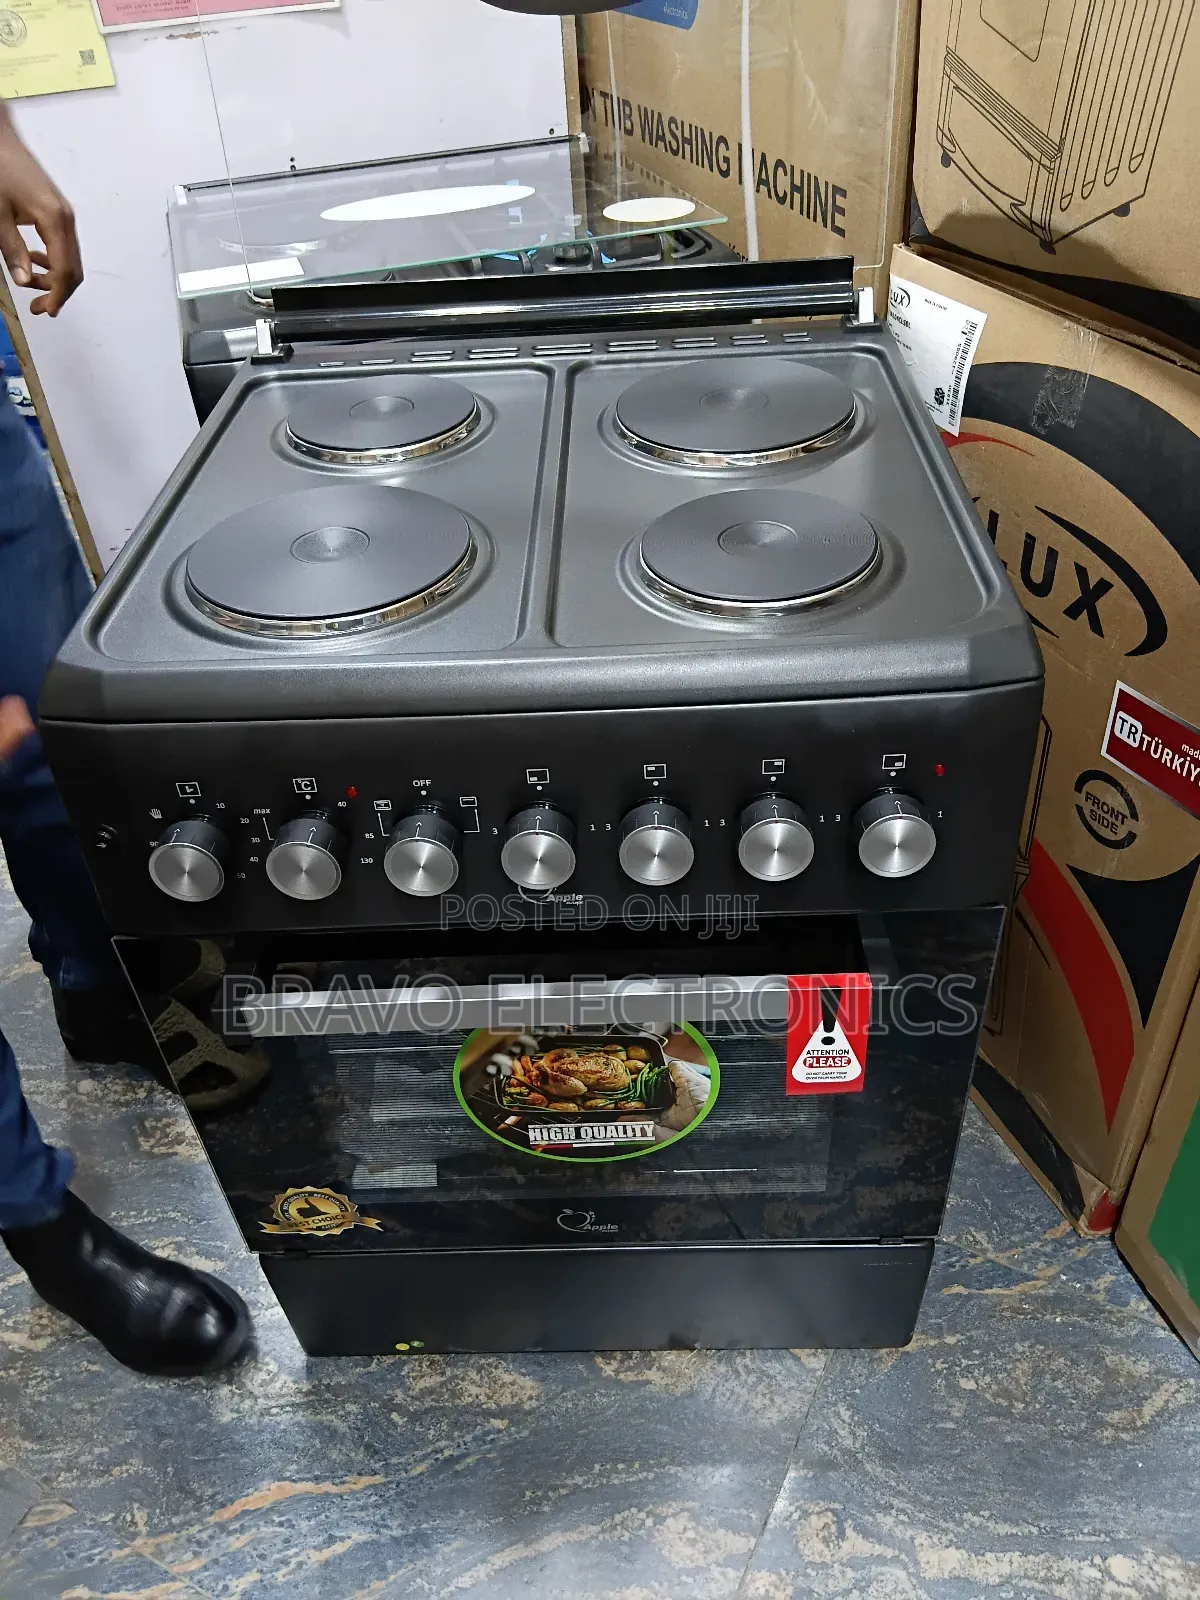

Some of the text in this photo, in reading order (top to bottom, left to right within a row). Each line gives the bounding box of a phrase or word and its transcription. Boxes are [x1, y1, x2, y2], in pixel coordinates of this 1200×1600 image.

[599, 90, 634, 137] TUB
[637, 103, 731, 179] WASHING
[1118, 716, 1200, 787] TR TÜRKİY
[1181, 743, 1200, 761] mad
[413, 779, 432, 788] OFF
[1084, 790, 1129, 825] FRONT
[719, 818, 726, 827] 3
[835, 813, 841, 822] 3
[1089, 808, 1119, 836] SIDE
[605, 823, 611, 831] 3
[546, 893, 584, 903] Apple
[805, 1057, 849, 1067] PLEASE
[528, 1124, 655, 1142] HIGH QUALITY
[287, 1220, 311, 1229] BEST
[312, 1213, 348, 1225] CHOICE
[583, 1223, 619, 1231] Apple
